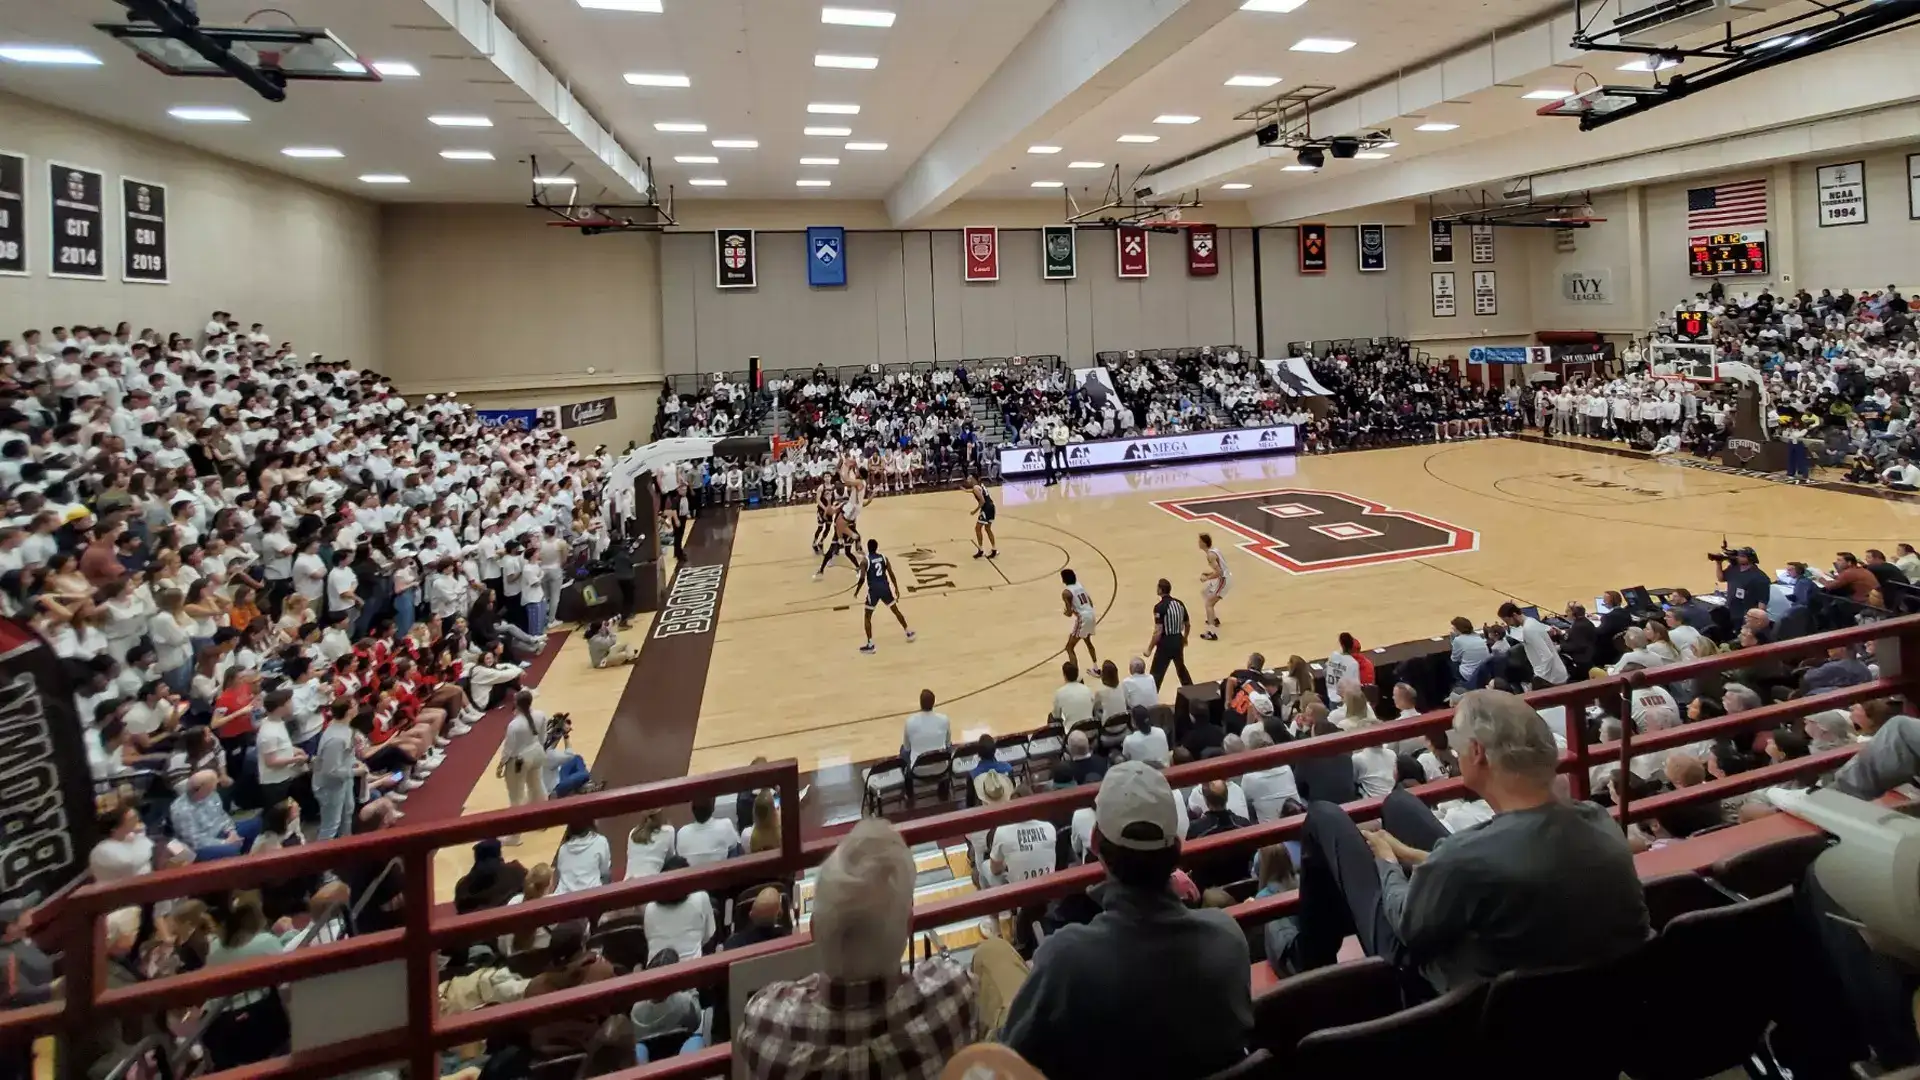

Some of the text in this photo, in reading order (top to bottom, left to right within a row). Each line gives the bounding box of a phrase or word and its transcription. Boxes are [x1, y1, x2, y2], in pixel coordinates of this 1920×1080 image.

[1829, 190, 1853, 199] NCAA
[1828, 207, 1856, 218] 1994
[65, 218, 90, 237] CIT
[135, 228, 156, 245] CBI
[1714, 233, 1740, 245] 19:12
[60, 246, 97, 266] 2014
[132, 254, 161, 271] 2019
[1706, 263, 1712, 271] 3
[1573, 279, 1602, 293] IVY
[1572, 293, 1604, 301] LEAGUE
[1532, 348, 1546, 363] B
[1562, 353, 1605, 363] SHAWMUT
[1153, 441, 1188, 452] MEGA
[1022, 461, 1046, 470] MEGA
[1150, 487, 1480, 576] B
[874, 562, 883, 577] 2
[906, 563, 957, 592] IVY
[653, 564, 724, 639] BROWN
[1077, 592, 1088, 605] 10
[0, 671, 74, 893] BROWN
